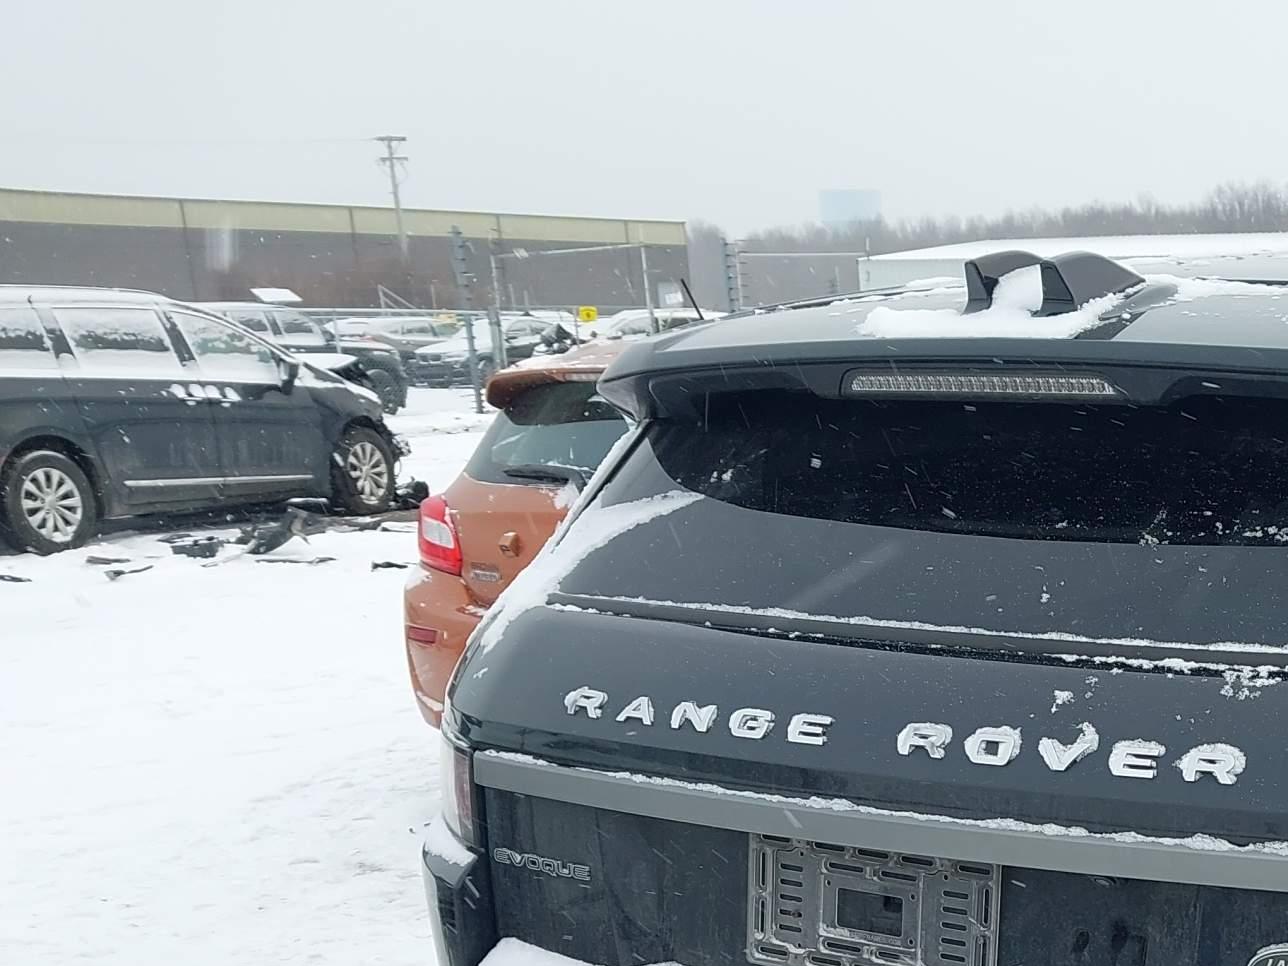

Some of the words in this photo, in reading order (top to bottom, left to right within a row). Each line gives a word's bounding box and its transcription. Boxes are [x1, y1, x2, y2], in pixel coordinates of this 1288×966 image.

[564, 686, 835, 745] RANGE
[896, 721, 1247, 785] ROVER
[494, 847, 591, 881] EVOQUE
